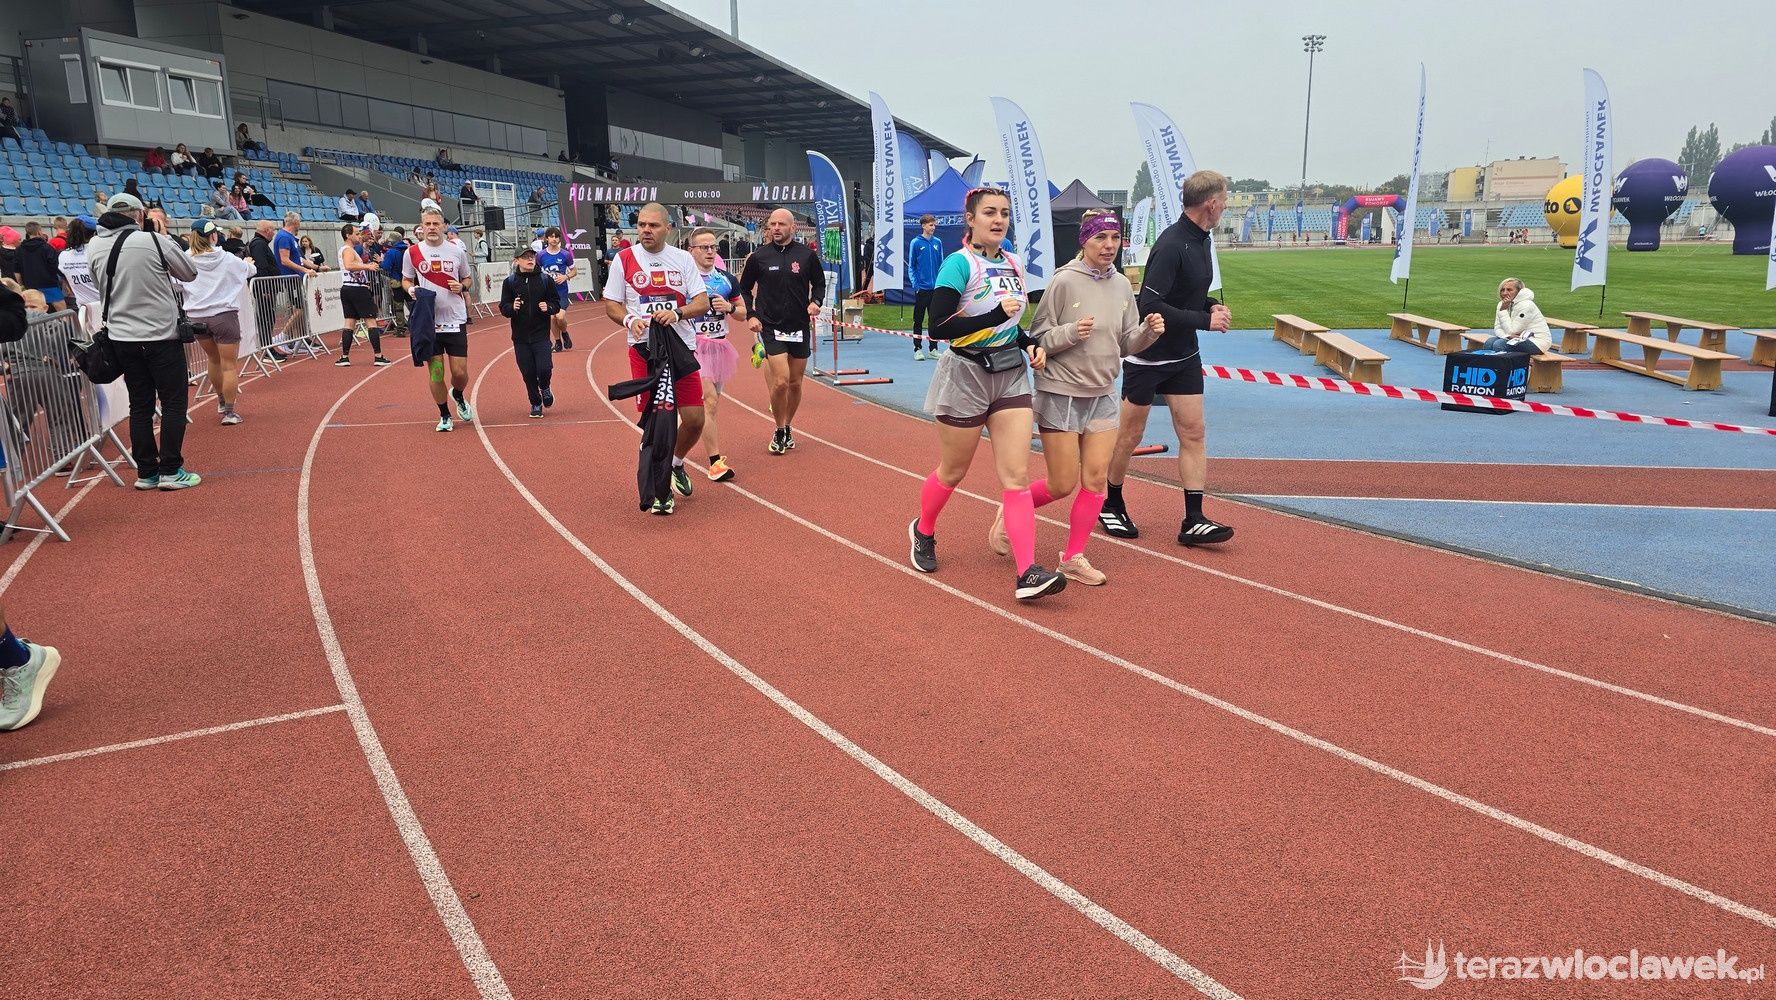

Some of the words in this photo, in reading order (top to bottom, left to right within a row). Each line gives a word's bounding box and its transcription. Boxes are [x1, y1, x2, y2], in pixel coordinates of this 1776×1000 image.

[569, 185, 658, 201] PÓŁMARATON
[684, 190, 721, 199] 00:00:00
[999, 277, 1022, 291] 418
[646, 302, 673, 314] 409
[700, 321, 722, 333] 686
[1452, 365, 1497, 387] HID
[1507, 367, 1526, 387] HID
[1451, 385, 1495, 396] RATION
[1506, 385, 1526, 396] RATION
